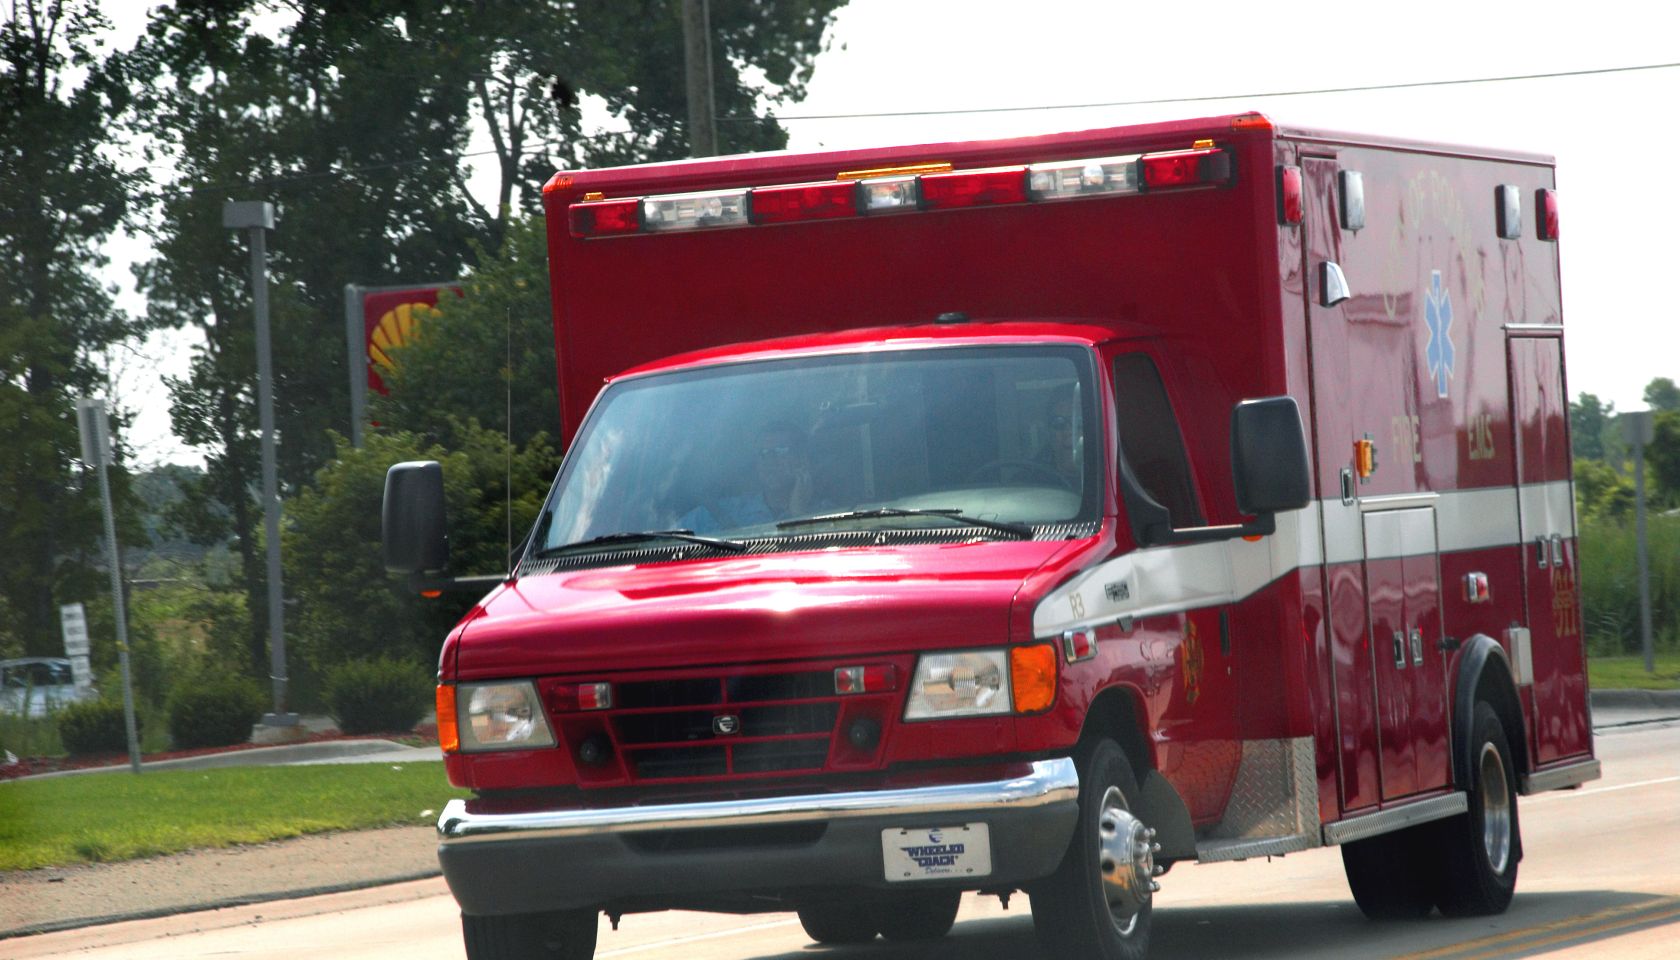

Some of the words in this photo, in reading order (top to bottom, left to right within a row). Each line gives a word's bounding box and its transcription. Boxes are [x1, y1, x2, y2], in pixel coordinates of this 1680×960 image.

[1068, 593, 1086, 621] R3
[901, 843, 965, 858] WHEELED
[912, 855, 955, 868] COACH
